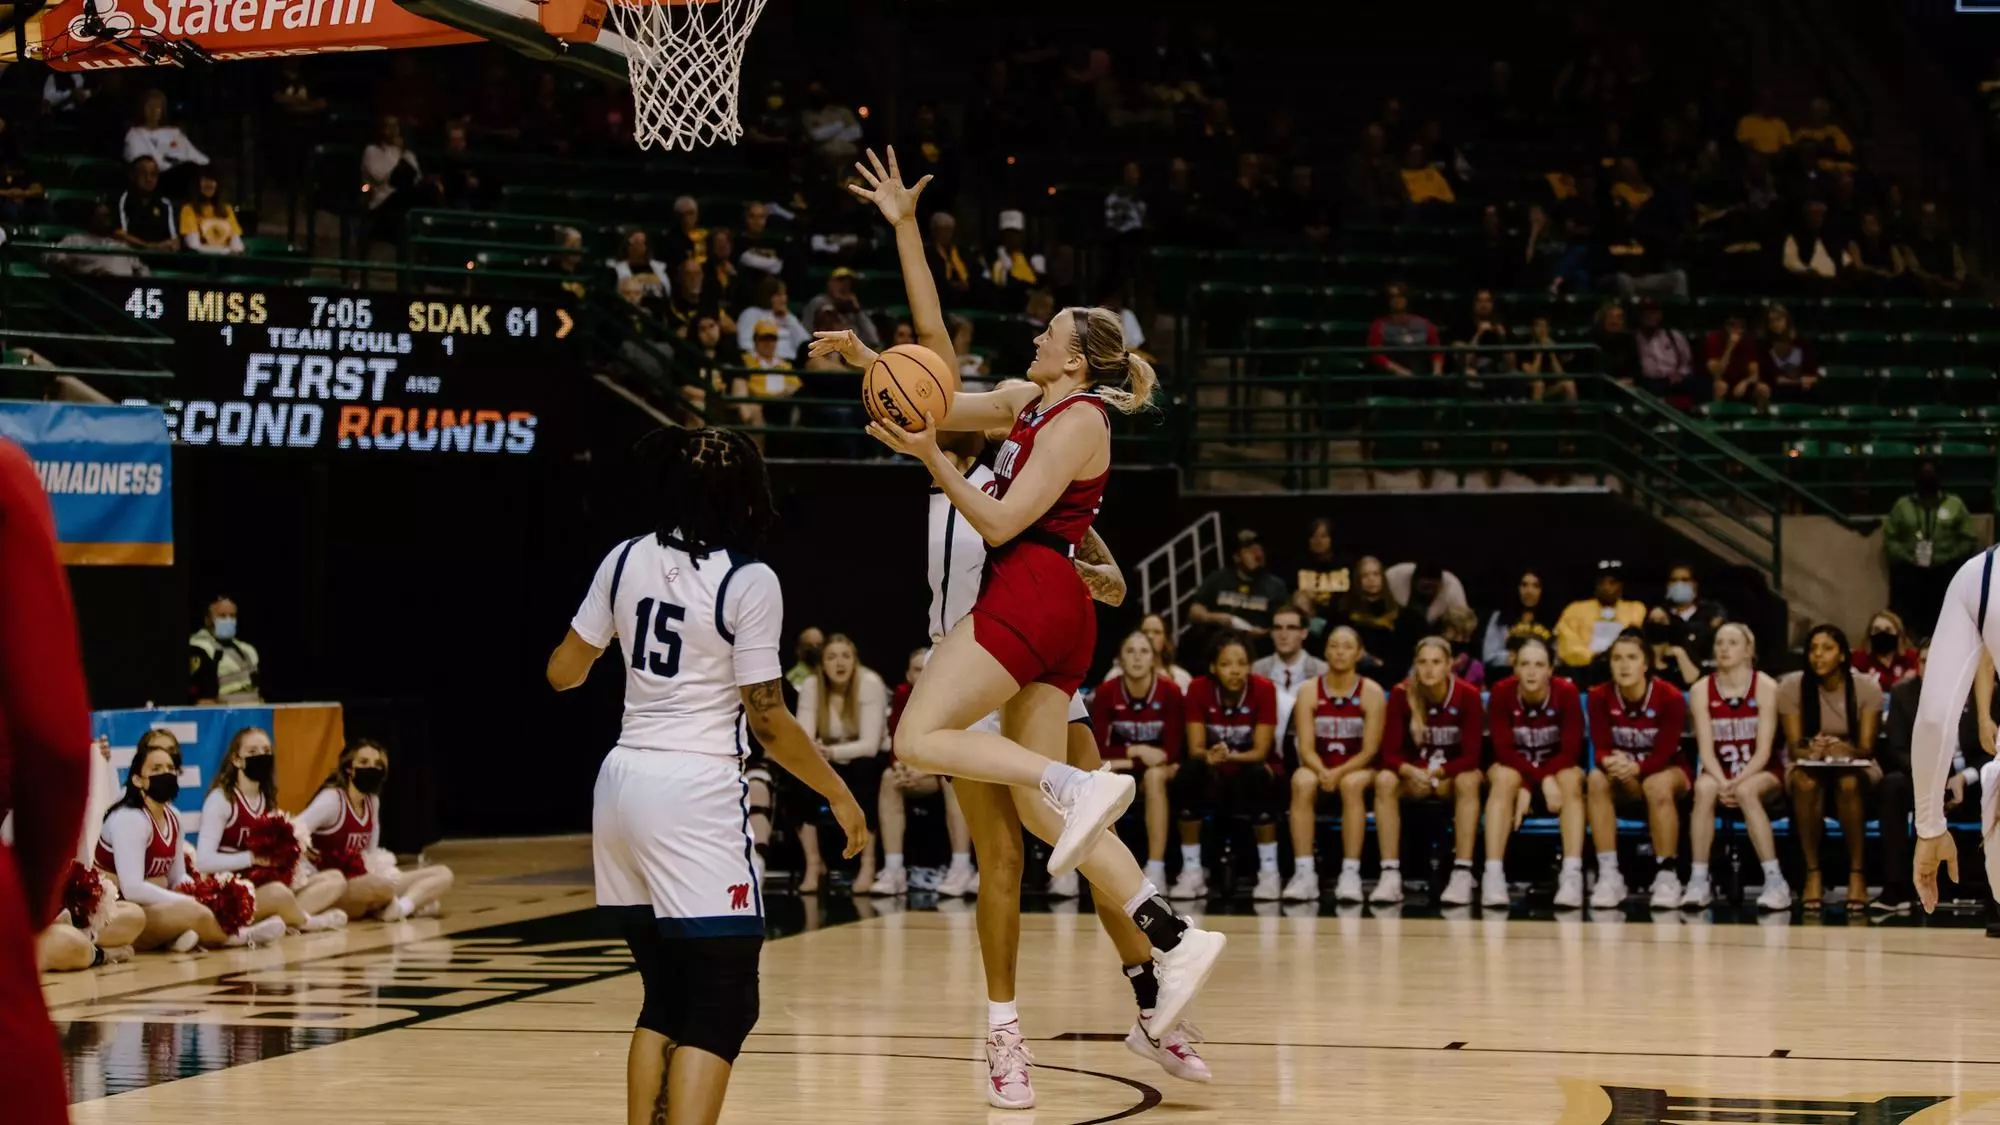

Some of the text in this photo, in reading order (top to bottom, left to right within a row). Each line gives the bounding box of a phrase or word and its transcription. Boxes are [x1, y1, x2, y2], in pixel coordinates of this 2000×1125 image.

[125, 288, 538, 337] 45 MISS 7:05 SDAK 61
[220, 325, 455, 356] 1 TEAM FOULS 1
[243, 353, 398, 401] FIRST
[121, 398, 538, 454] ECOND ROUNDS
[33, 460, 164, 495] HMADNESS
[631, 597, 686, 678] 15
